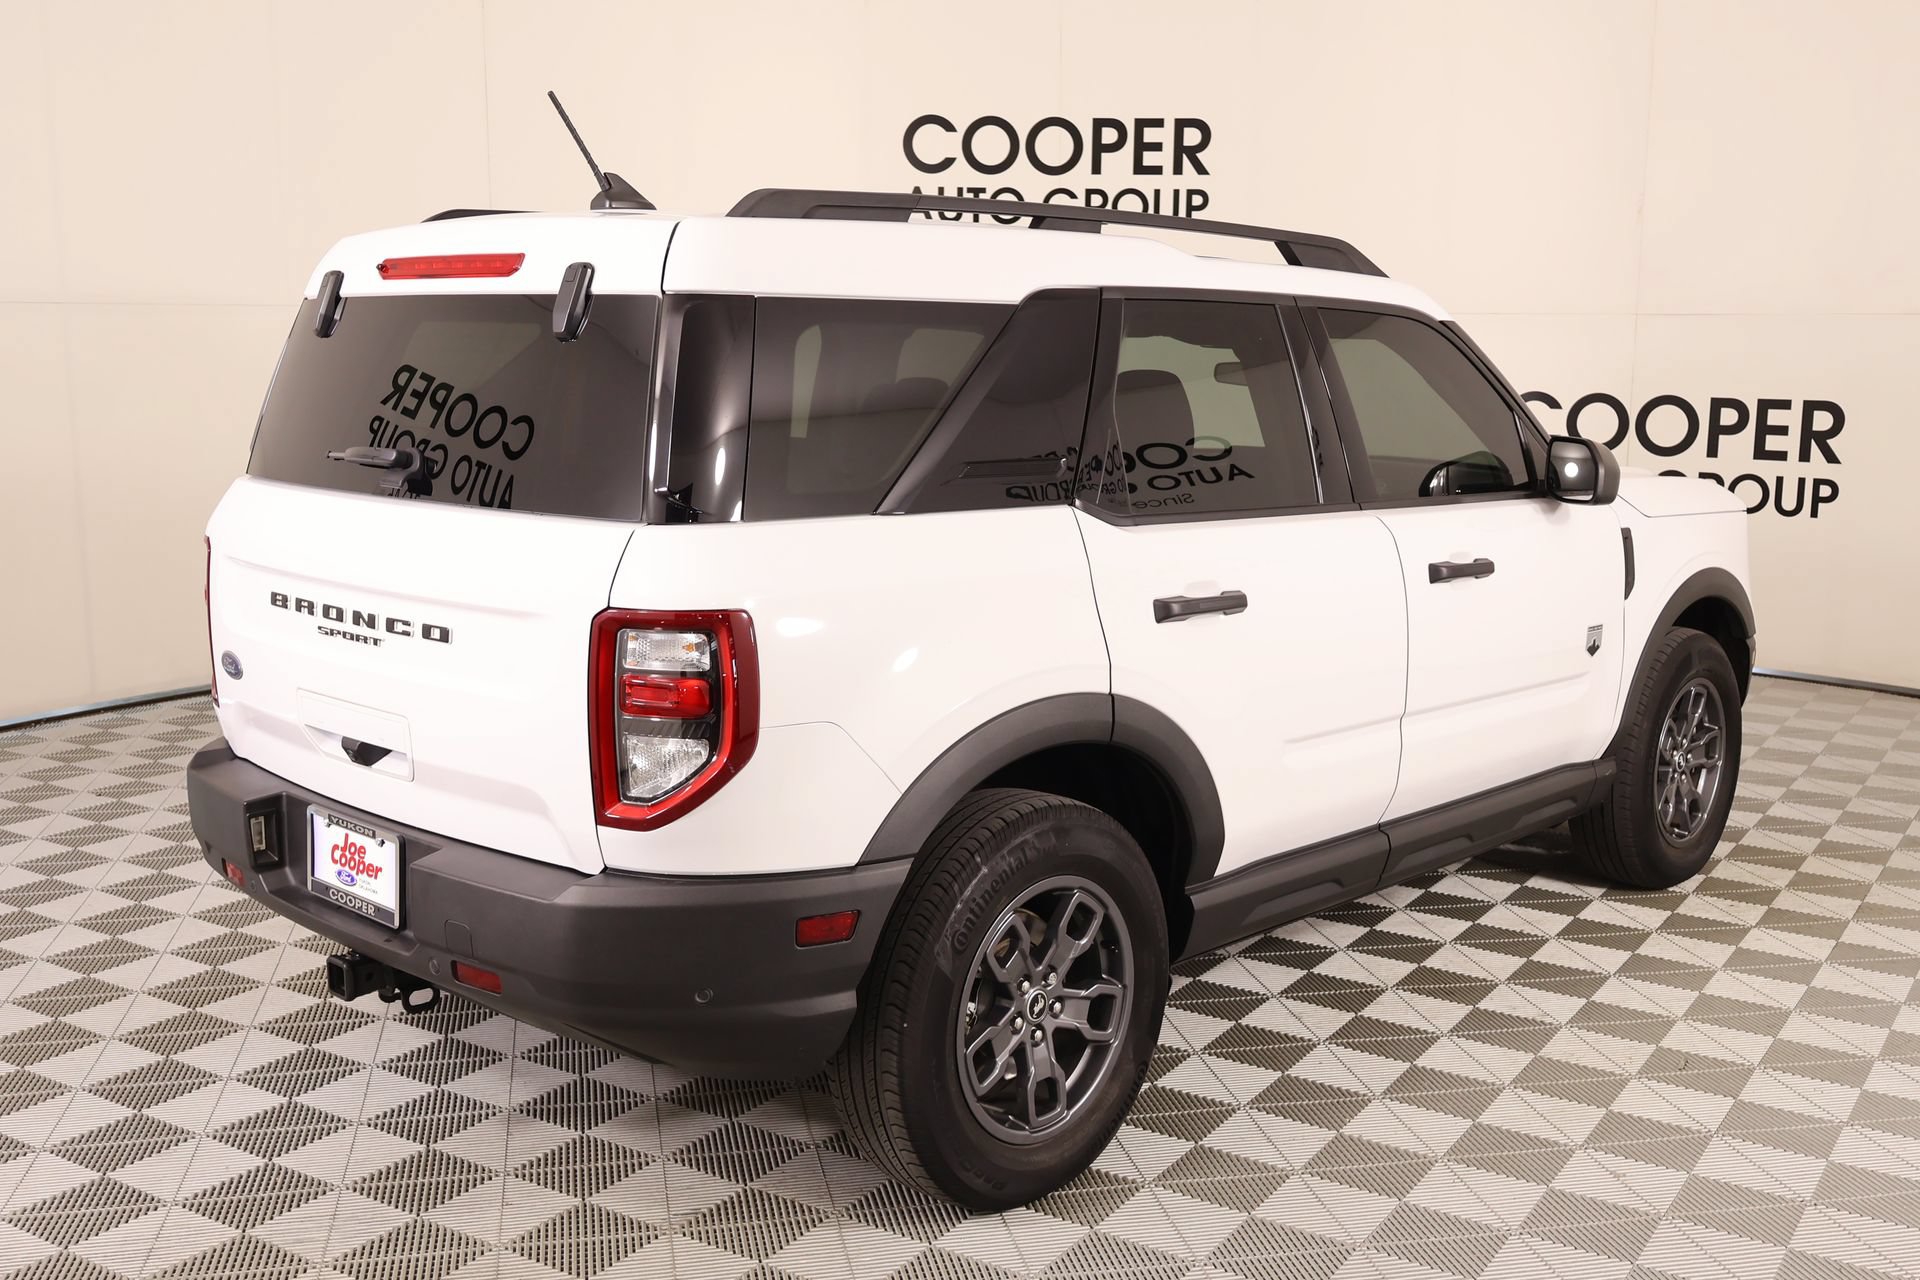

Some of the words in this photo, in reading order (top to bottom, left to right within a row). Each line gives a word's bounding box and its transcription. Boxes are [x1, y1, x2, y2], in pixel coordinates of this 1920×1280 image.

[903, 114, 1212, 176] COOPER
[270, 591, 453, 644] BRONCO
[317, 625, 385, 647] SPORT
[330, 816, 373, 837] YUKON
[341, 832, 366, 859] Joe
[330, 843, 383, 880] Cooper
[329, 888, 376, 917] COOPER
